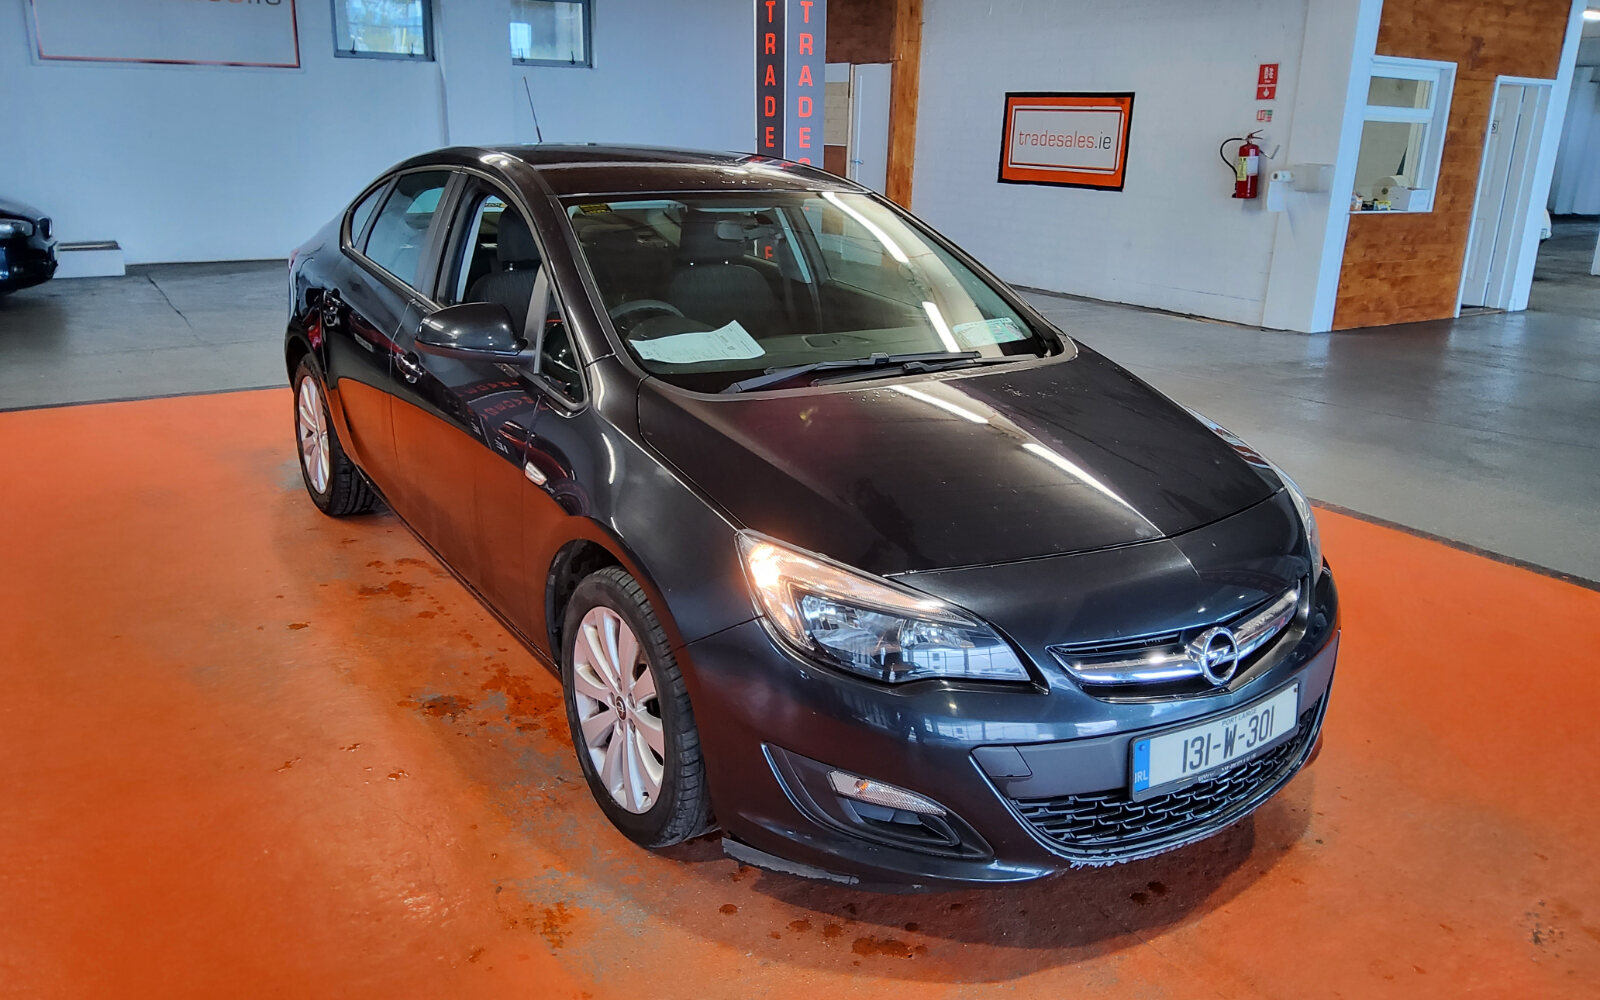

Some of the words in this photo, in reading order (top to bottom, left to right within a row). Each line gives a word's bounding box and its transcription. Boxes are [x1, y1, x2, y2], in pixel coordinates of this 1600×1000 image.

[1018, 129, 1112, 150] tradesales.ie
[1181, 705, 1275, 774] 131-W-301
[1134, 769, 1149, 784] IRL
